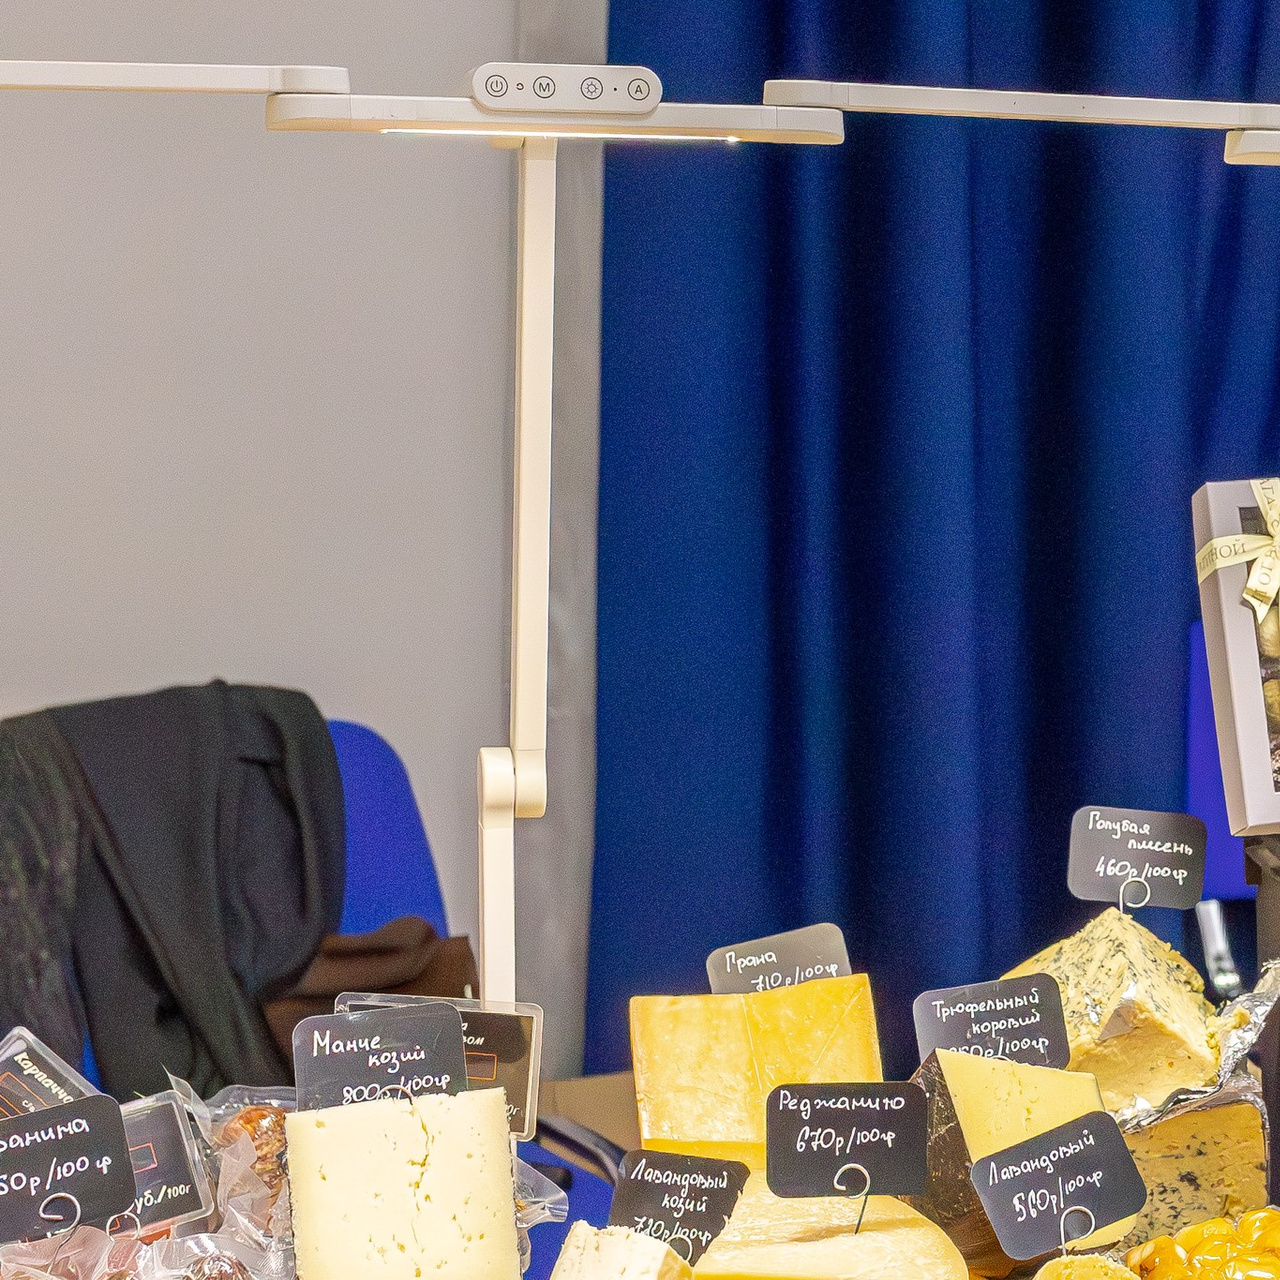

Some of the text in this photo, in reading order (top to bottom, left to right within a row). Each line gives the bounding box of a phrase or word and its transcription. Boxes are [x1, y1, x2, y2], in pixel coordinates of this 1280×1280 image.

[1089, 811, 1150, 839] Голубая
[932, 987, 1039, 1022] Трюфельный
[972, 1009, 1040, 1038] коровий
[313, 1030, 381, 1057] Манче
[368, 1045, 426, 1073] козий
[989, 1129, 1095, 1186] Лавандовый
[630, 1158, 728, 1197] Лавандовый
[662, 1193, 708, 1218] козий
